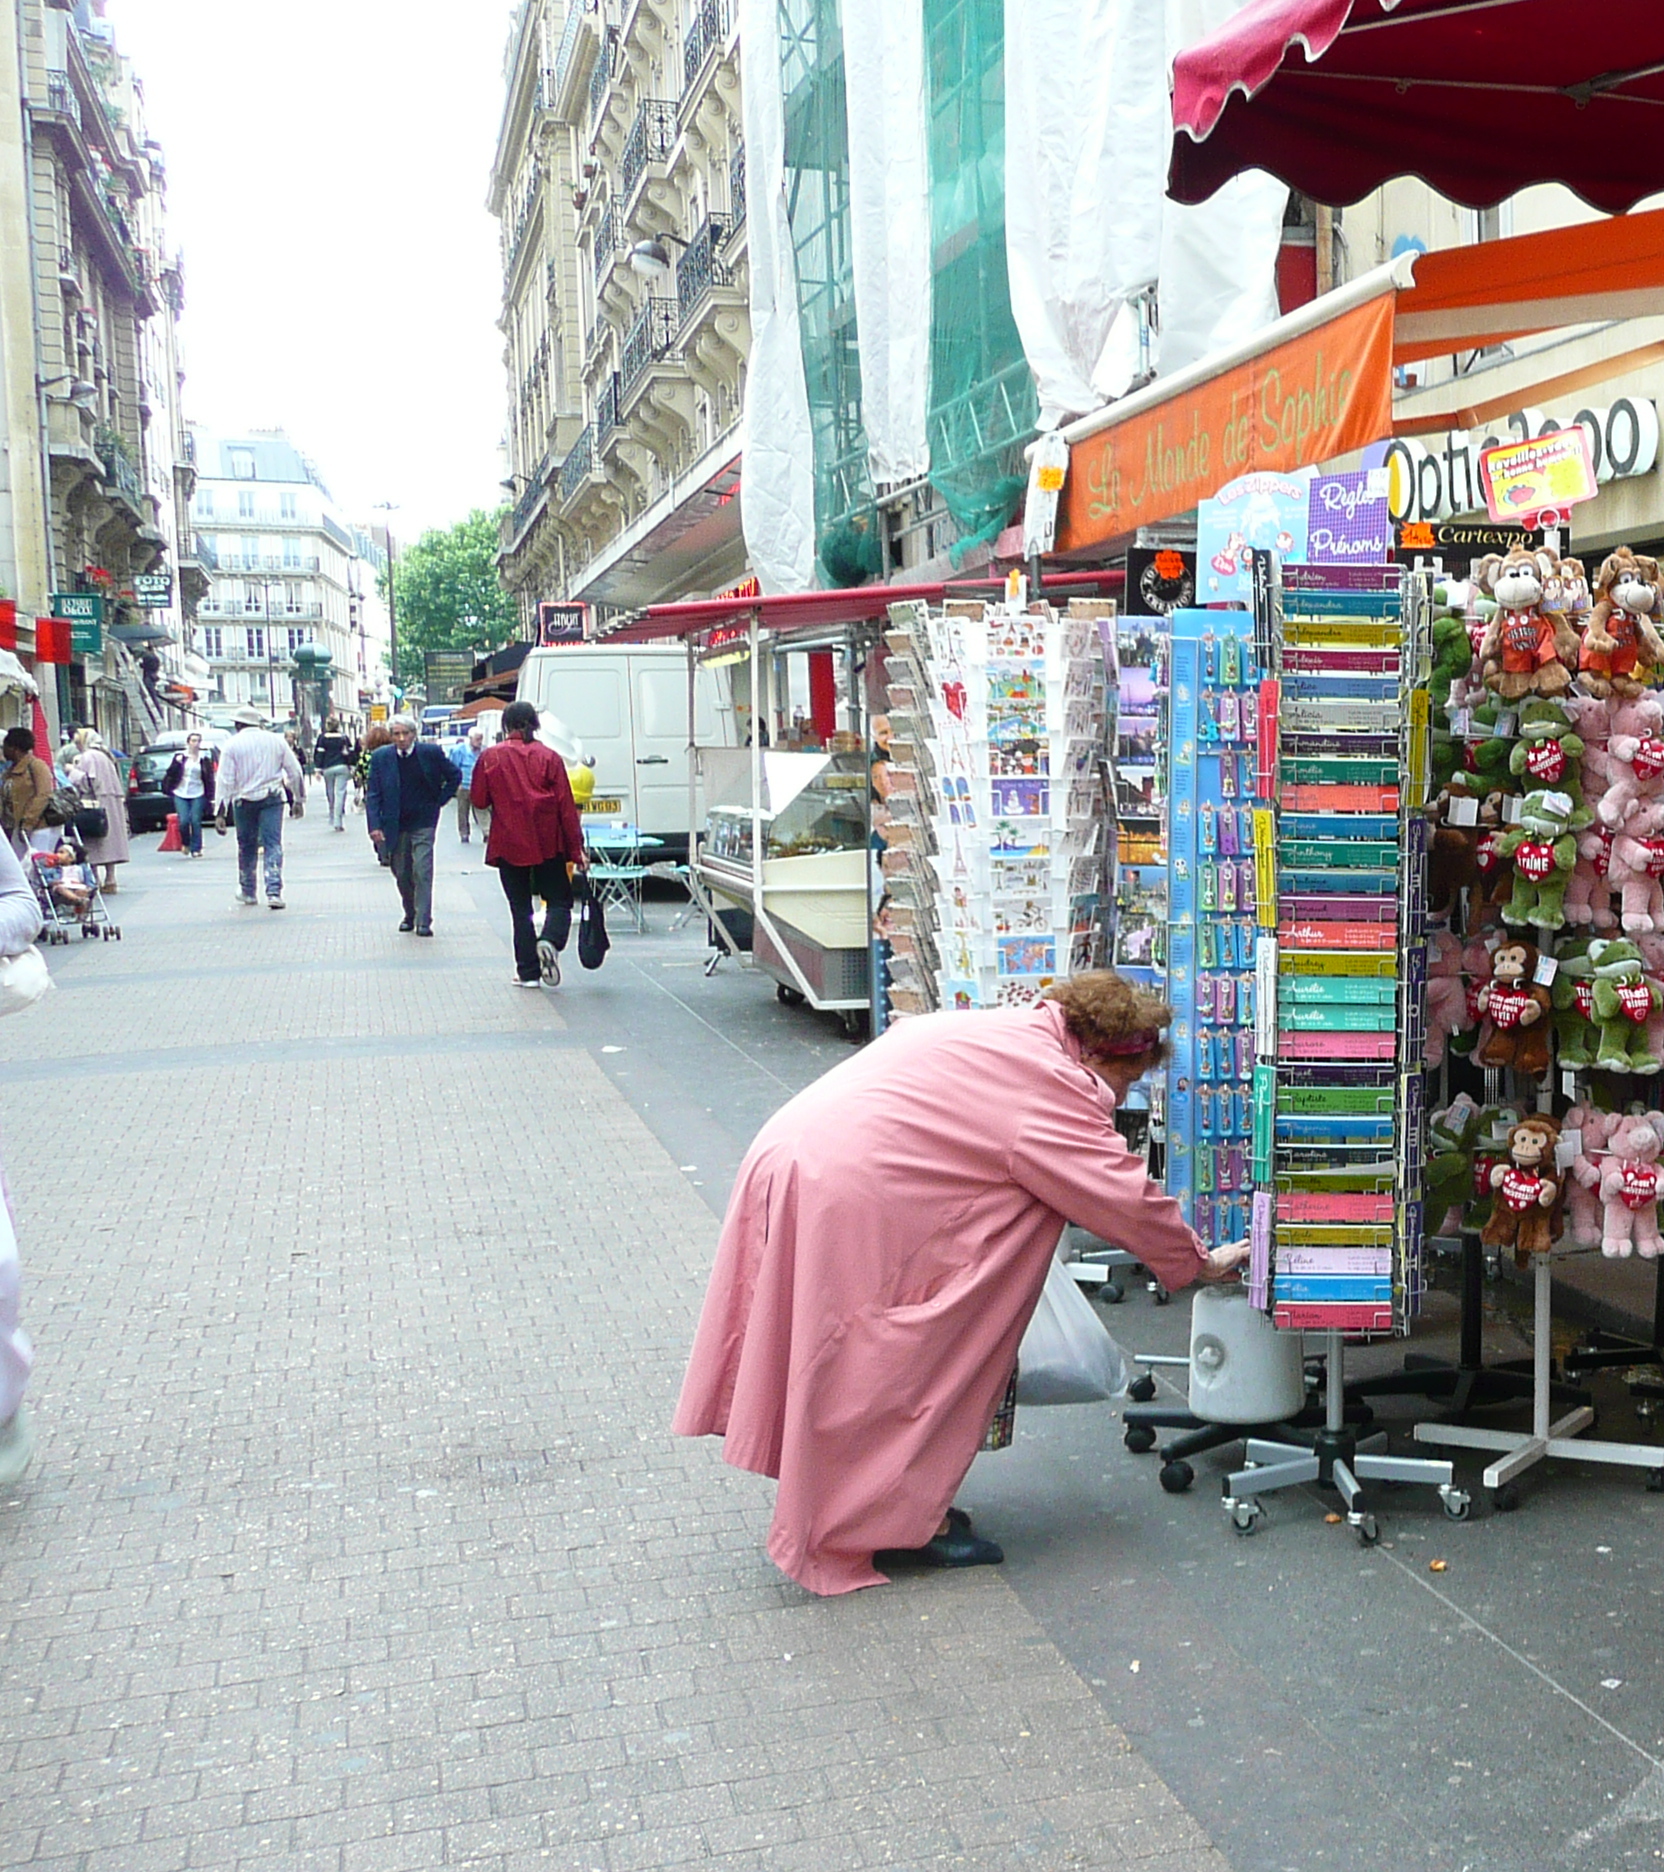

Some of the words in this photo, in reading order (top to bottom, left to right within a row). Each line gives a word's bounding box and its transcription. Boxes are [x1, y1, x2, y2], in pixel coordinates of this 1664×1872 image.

[1086, 443, 1121, 520] Le
[1130, 410, 1210, 506] Monde
[1223, 391, 1248, 467] de
[1259, 350, 1352, 464] Sophie
[1311, 529, 1383, 556] Prénoms
[1438, 525, 1534, 548] Cartexpo
[1285, 925, 1324, 938] Arthur
[1286, 981, 1325, 994] Aurélie
[1286, 1009, 1325, 1022] Aurélie
